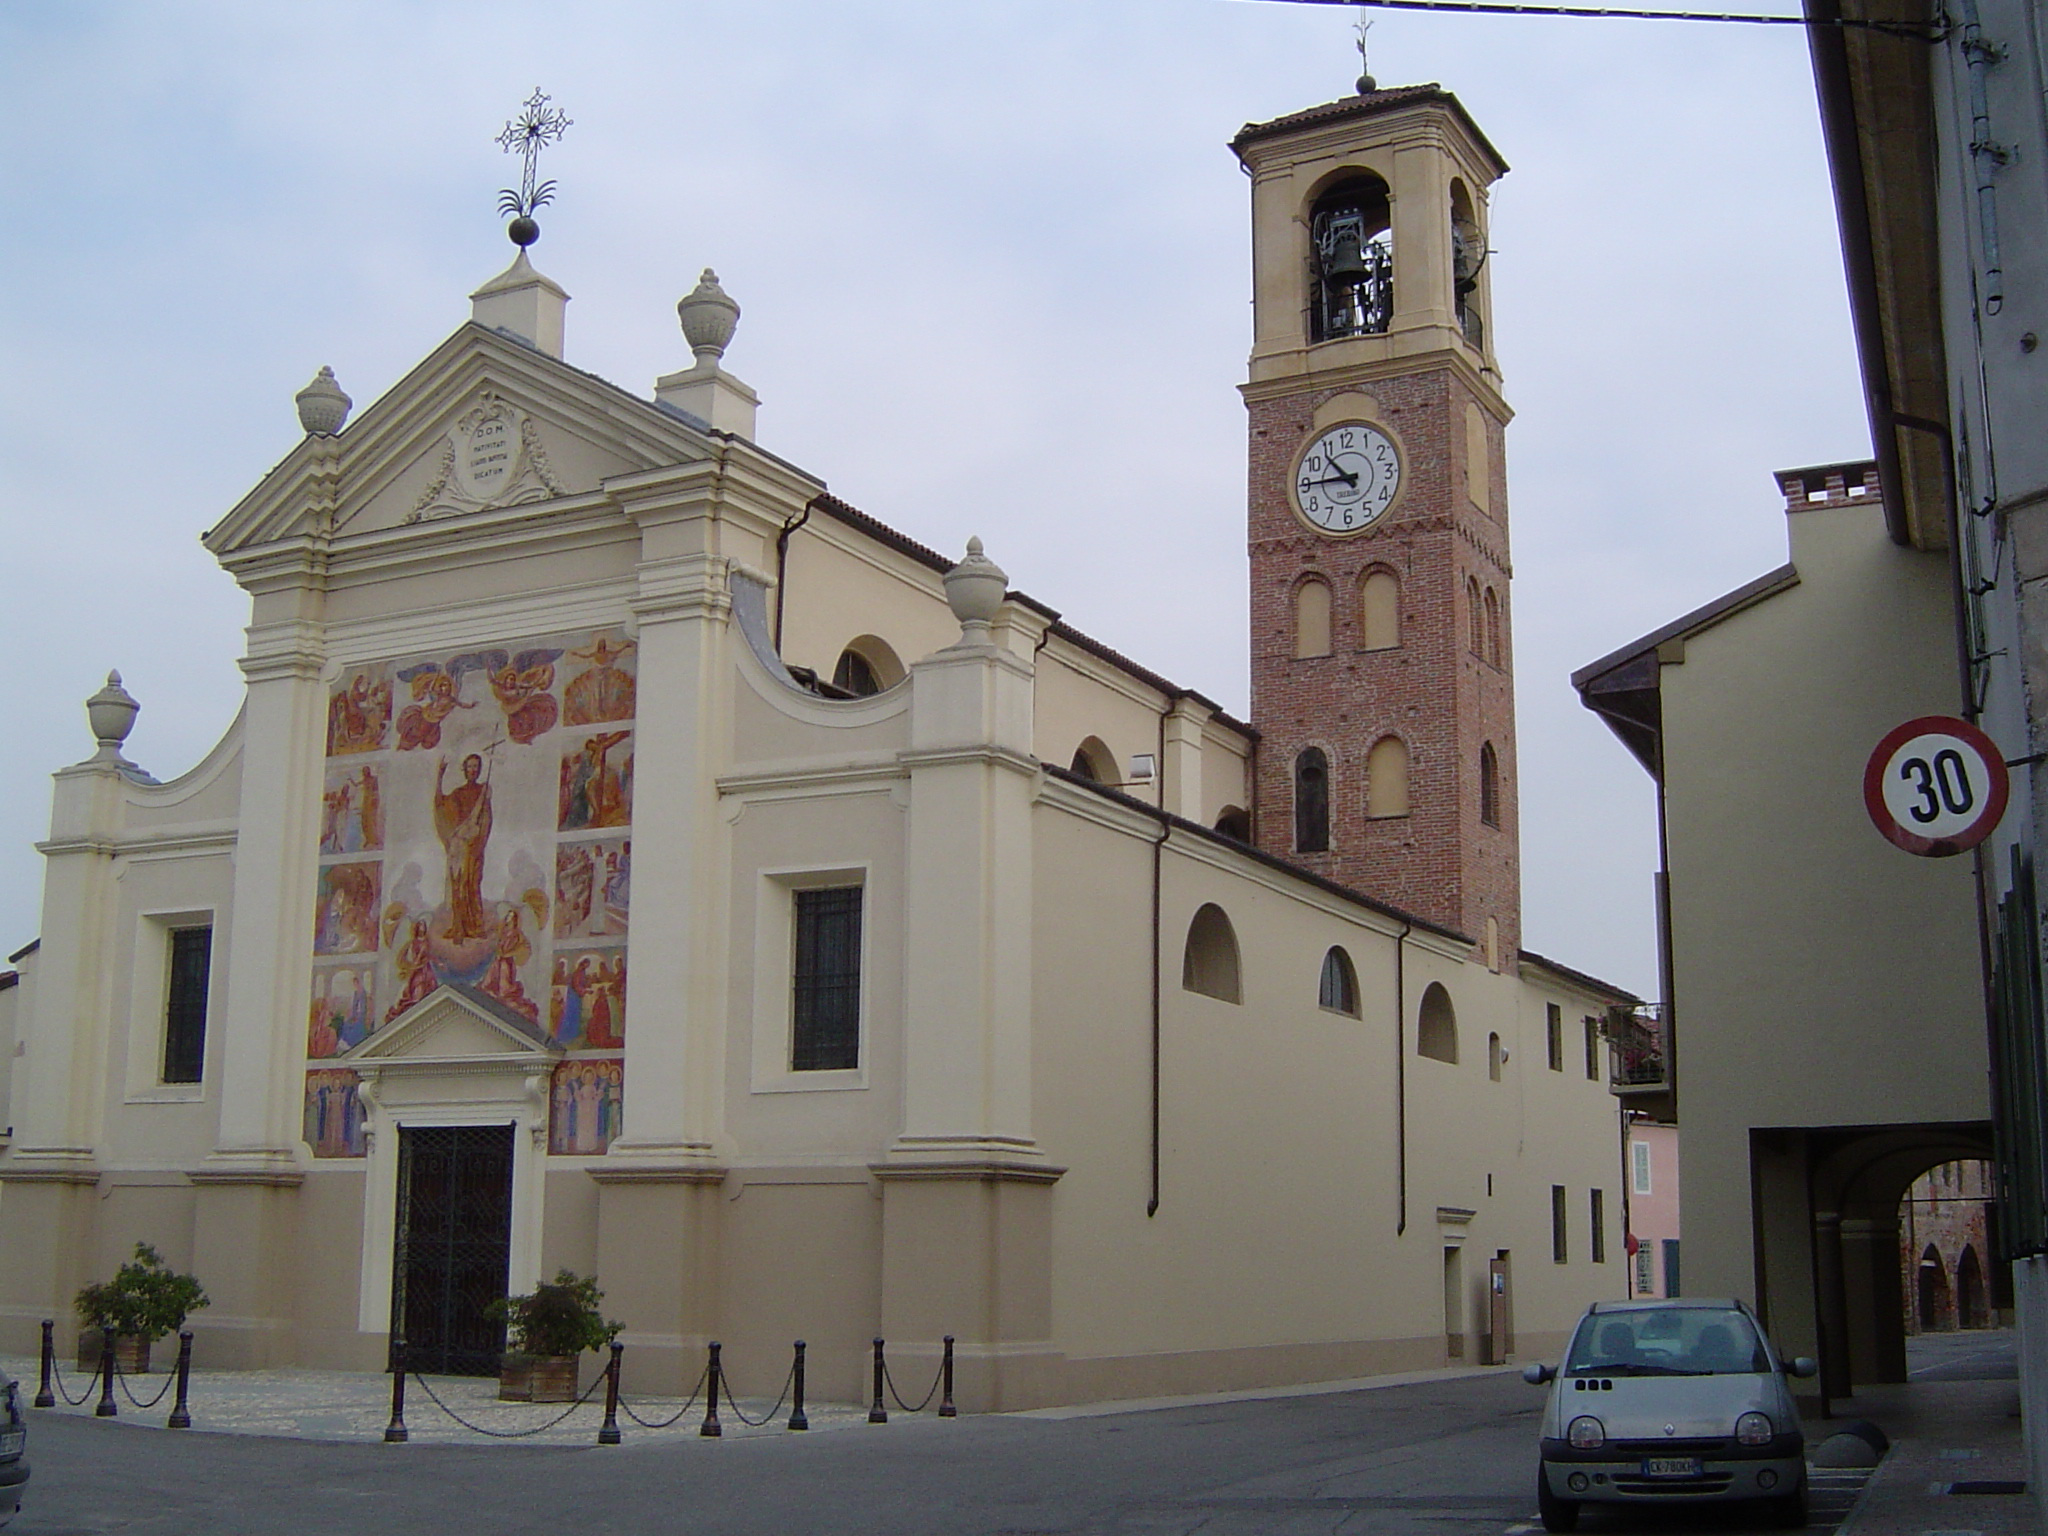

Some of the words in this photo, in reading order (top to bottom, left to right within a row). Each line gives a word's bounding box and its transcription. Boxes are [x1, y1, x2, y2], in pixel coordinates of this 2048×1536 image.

[1323, 441, 1333, 456] 11
[1340, 432, 1354, 449] 12
[1363, 433, 1368, 449] 1
[1376, 445, 1386, 461] 2
[1308, 456, 1321, 472] 10
[1384, 463, 1393, 480] 3
[1301, 477, 1310, 493] 9
[1378, 485, 1388, 501] 4
[1309, 496, 1318, 512] 8
[1362, 501, 1372, 517] 5
[1324, 507, 1334, 523] 7
[1343, 509, 1353, 525] 6
[1900, 749, 1973, 823] 30
